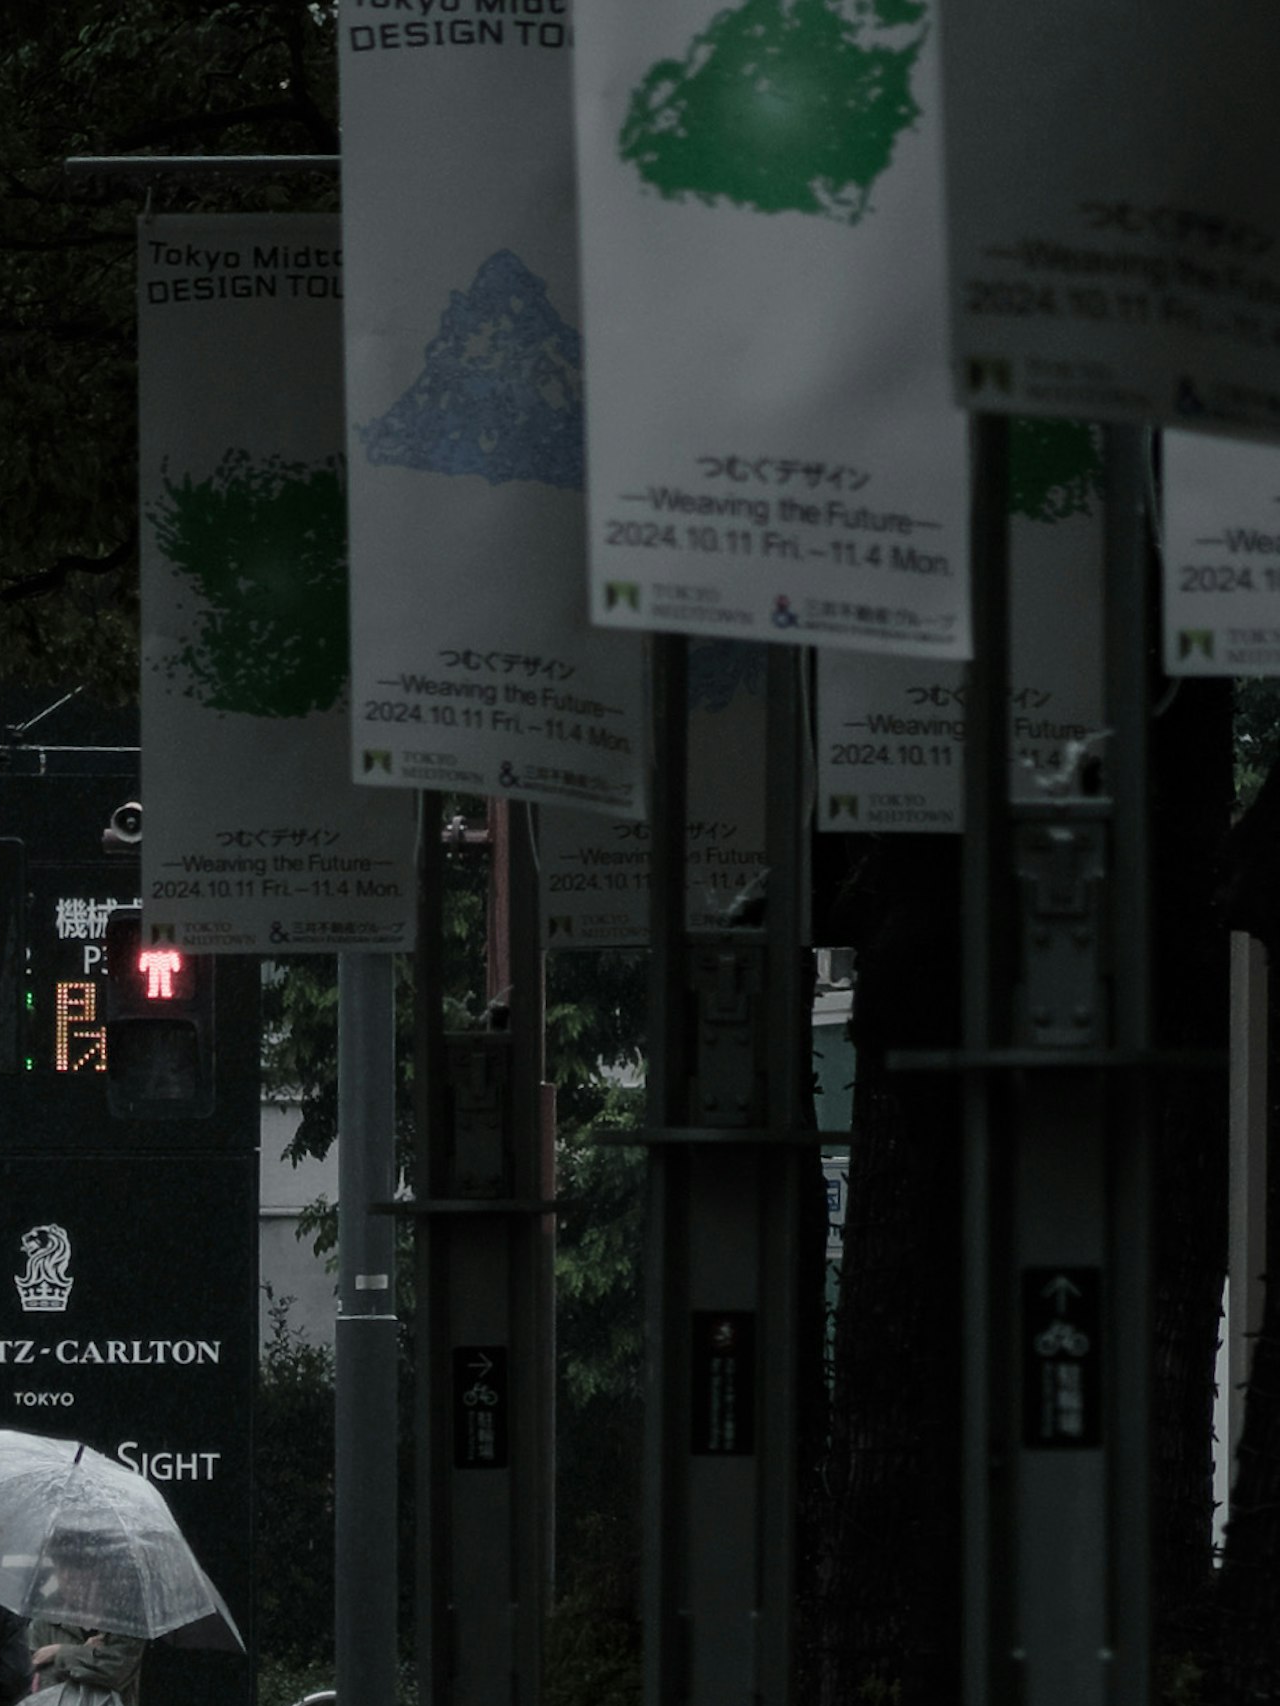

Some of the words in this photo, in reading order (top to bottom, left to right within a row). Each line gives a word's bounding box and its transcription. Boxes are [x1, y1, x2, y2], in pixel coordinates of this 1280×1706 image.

[350, 19, 503, 51] DESIGN
[514, 19, 575, 49] TO
[149, 241, 240, 273] Tokyo
[148, 276, 277, 304] DESIGN
[777, 495, 821, 525] the
[605, 519, 753, 557] 2024.10.11
[888, 545, 955, 579] Mon.
[504, 683, 537, 706] the
[365, 701, 484, 730] 2024.10.11
[587, 726, 632, 753] Mon.
[831, 744, 953, 767] 2024.10.11
[273, 855, 303, 872] the
[152, 880, 255, 899] 2024.10.11
[356, 881, 402, 898] Mon.
[549, 873, 651, 893] 2024.10.11
[13, 1391, 75, 1408] TOKYO
